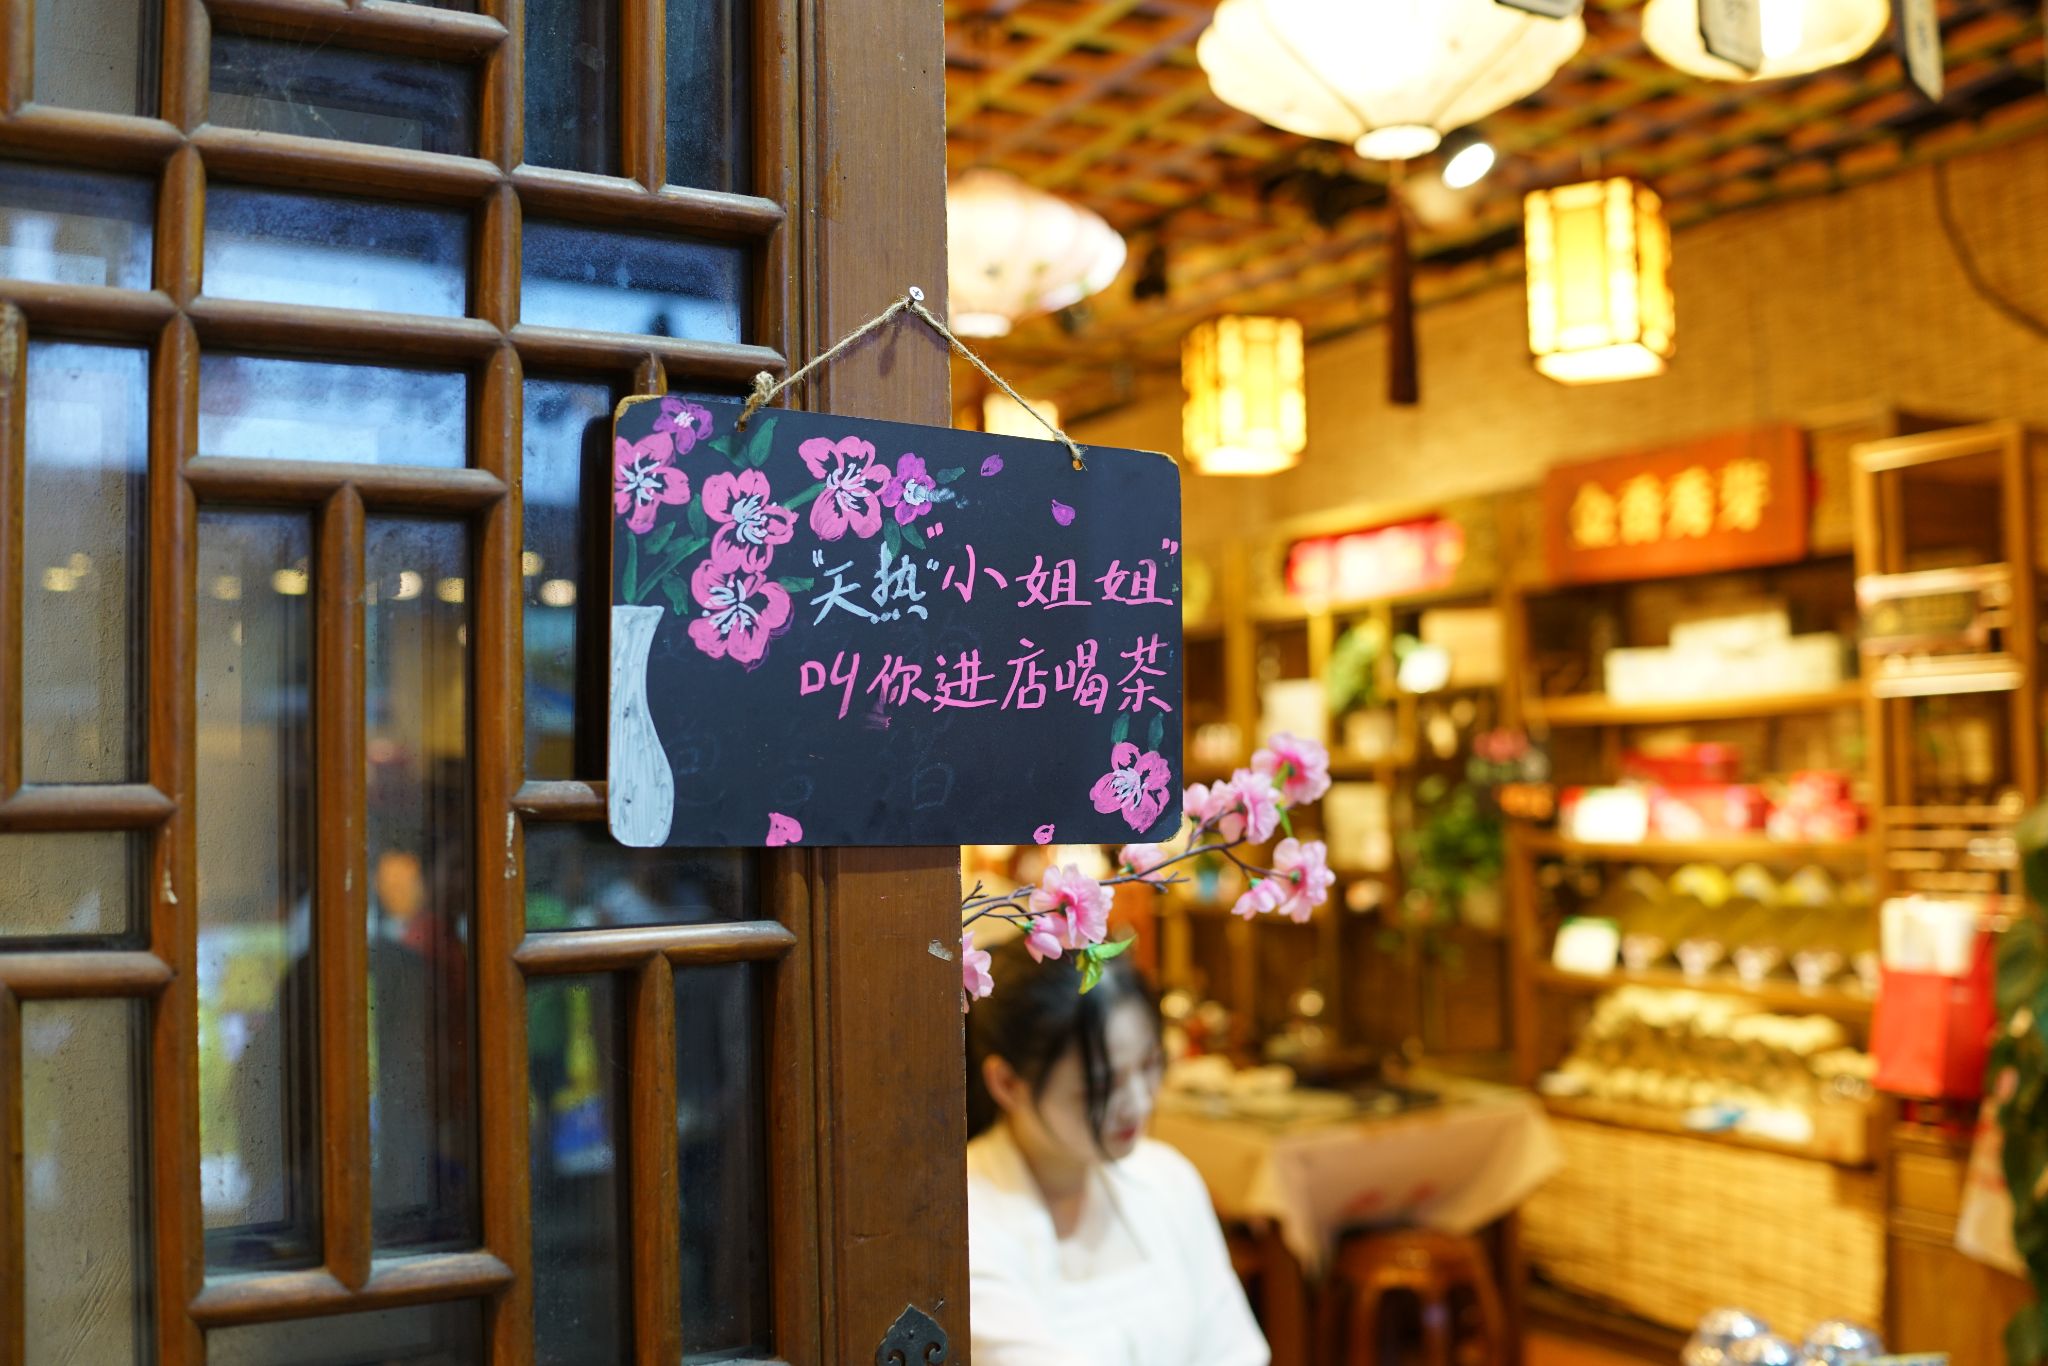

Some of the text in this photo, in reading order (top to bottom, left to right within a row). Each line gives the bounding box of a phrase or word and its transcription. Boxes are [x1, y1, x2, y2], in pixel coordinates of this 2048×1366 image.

[800, 633, 1173, 719] 叫你进店喝茶
